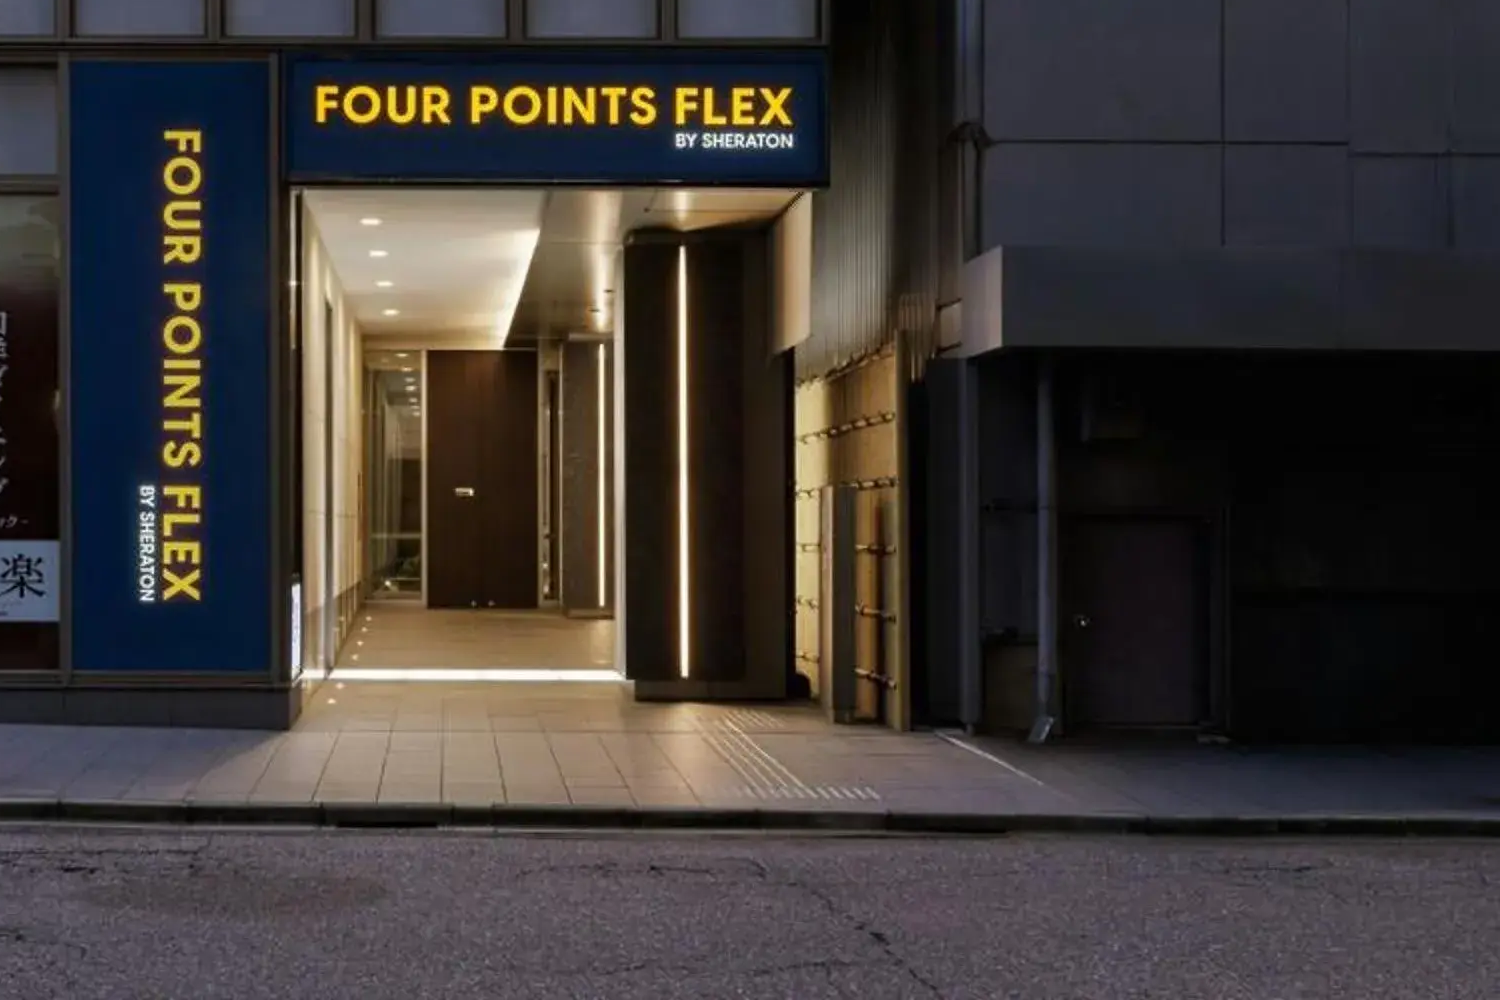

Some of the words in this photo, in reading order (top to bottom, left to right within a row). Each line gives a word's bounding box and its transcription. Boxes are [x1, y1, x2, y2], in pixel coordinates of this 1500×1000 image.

[314, 86, 451, 124] FOUR
[470, 87, 657, 125] POINTS
[674, 87, 793, 126] FLEX
[675, 132, 697, 149] BY
[701, 132, 794, 149] SHERATON
[163, 130, 202, 264] FOUR
[163, 283, 202, 468] POINTS
[139, 485, 156, 508] BY
[139, 511, 156, 602] SHERATON
[162, 486, 201, 601] FLEX
